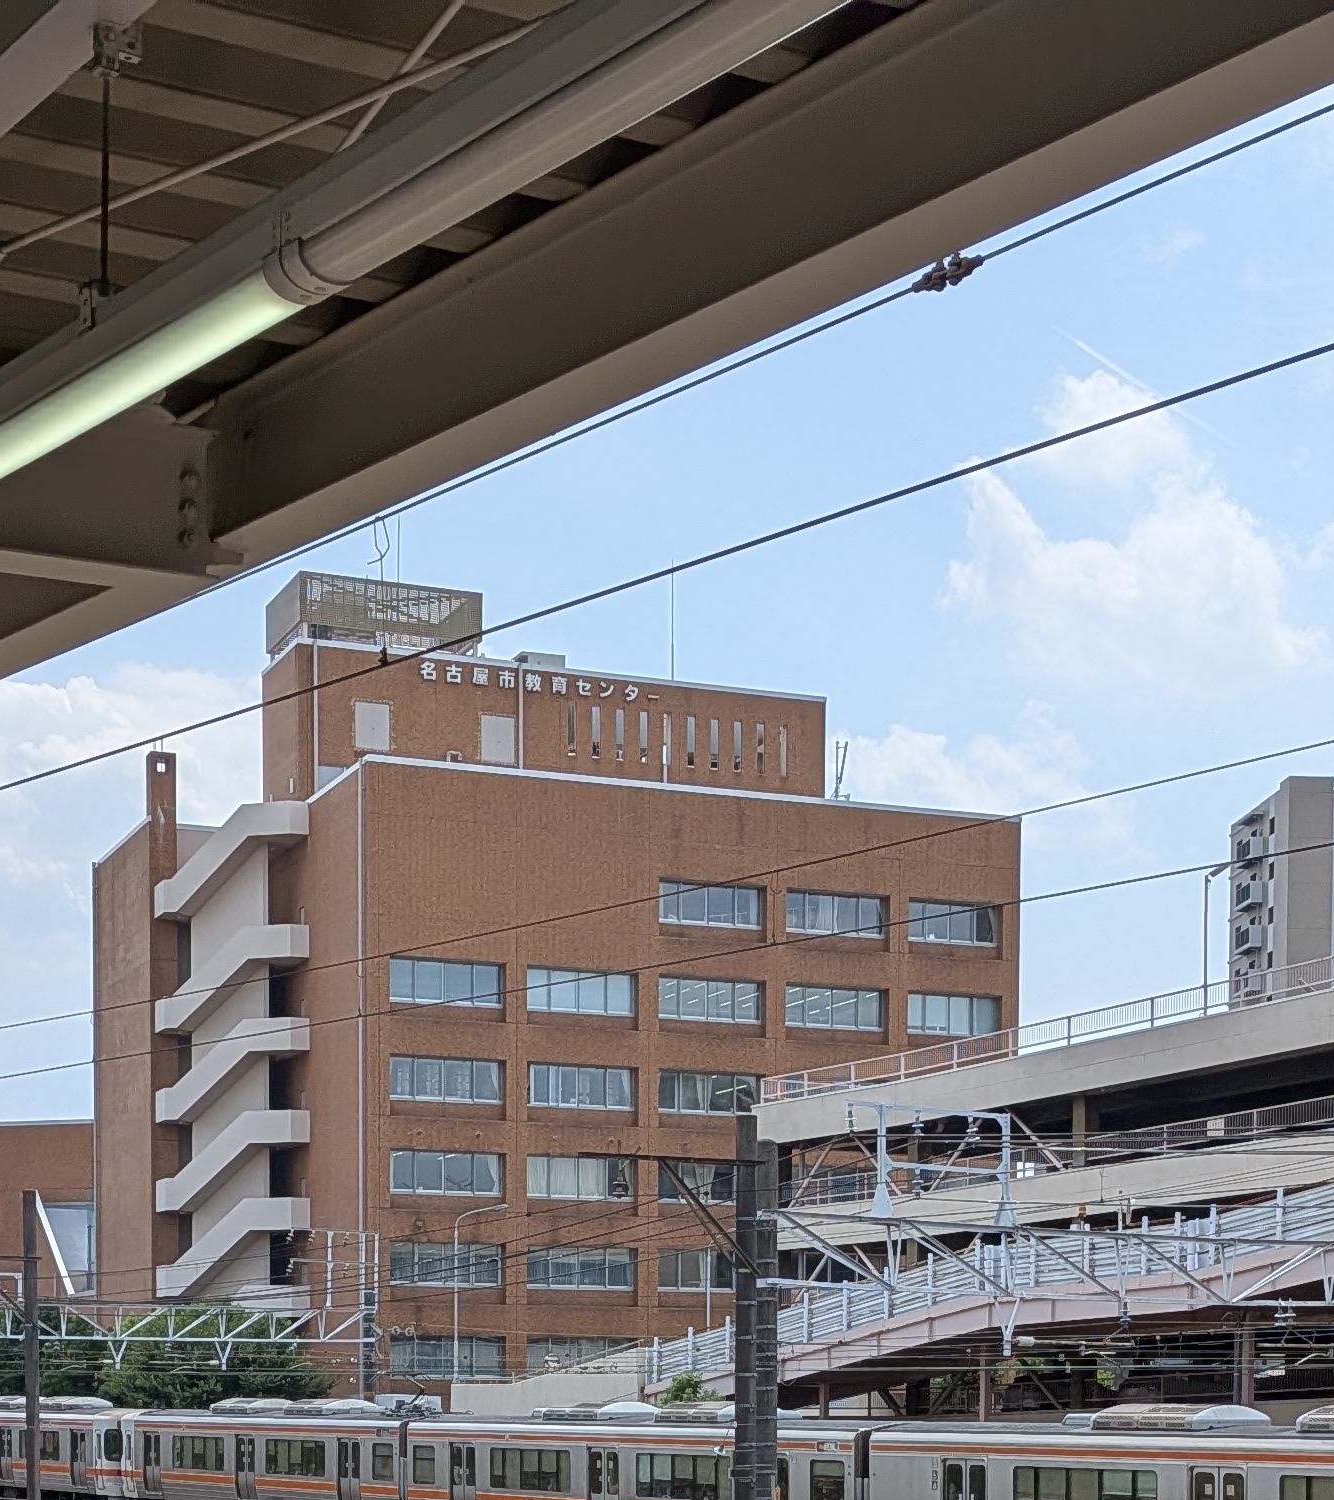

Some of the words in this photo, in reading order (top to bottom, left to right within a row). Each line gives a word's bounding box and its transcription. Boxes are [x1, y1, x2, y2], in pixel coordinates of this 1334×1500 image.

[419, 661, 660, 702] 名古屋市教育センター
